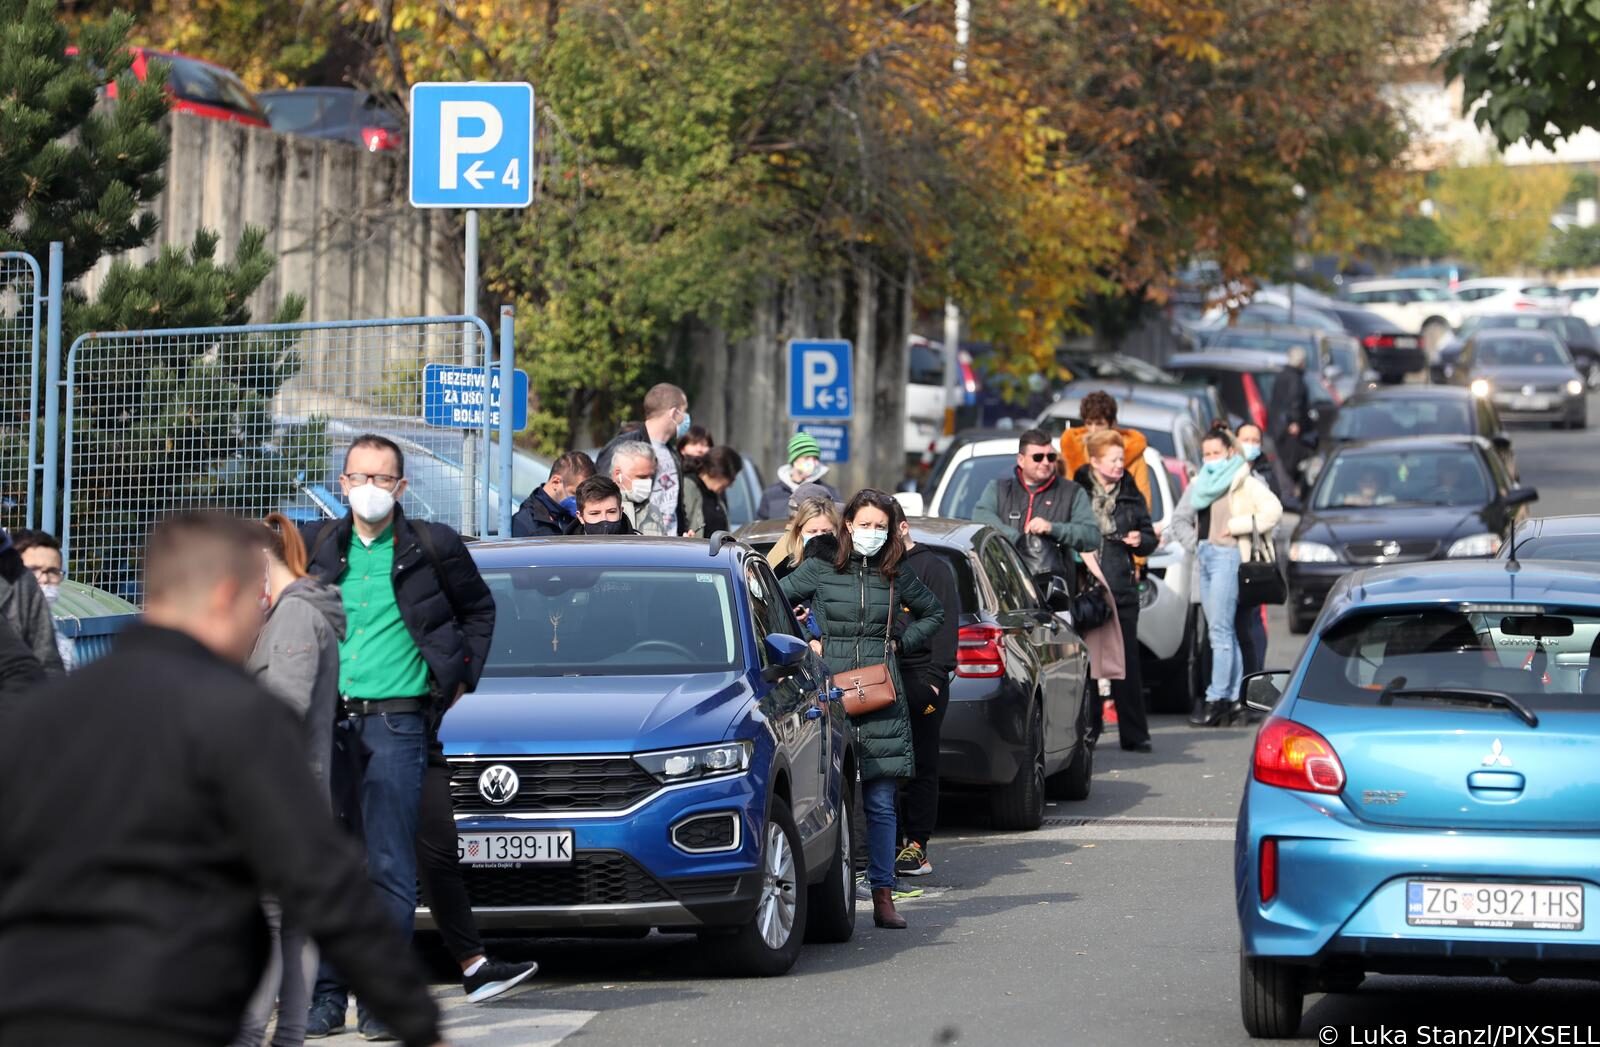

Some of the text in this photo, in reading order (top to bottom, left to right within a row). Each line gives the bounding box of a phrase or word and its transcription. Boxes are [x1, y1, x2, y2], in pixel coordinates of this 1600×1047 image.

[439, 100, 520, 190] P 4
[444, 389, 459, 404] ZA
[803, 350, 849, 410] P 5
[1409, 903, 1423, 912] HR
[1426, 887, 1458, 913] ZG
